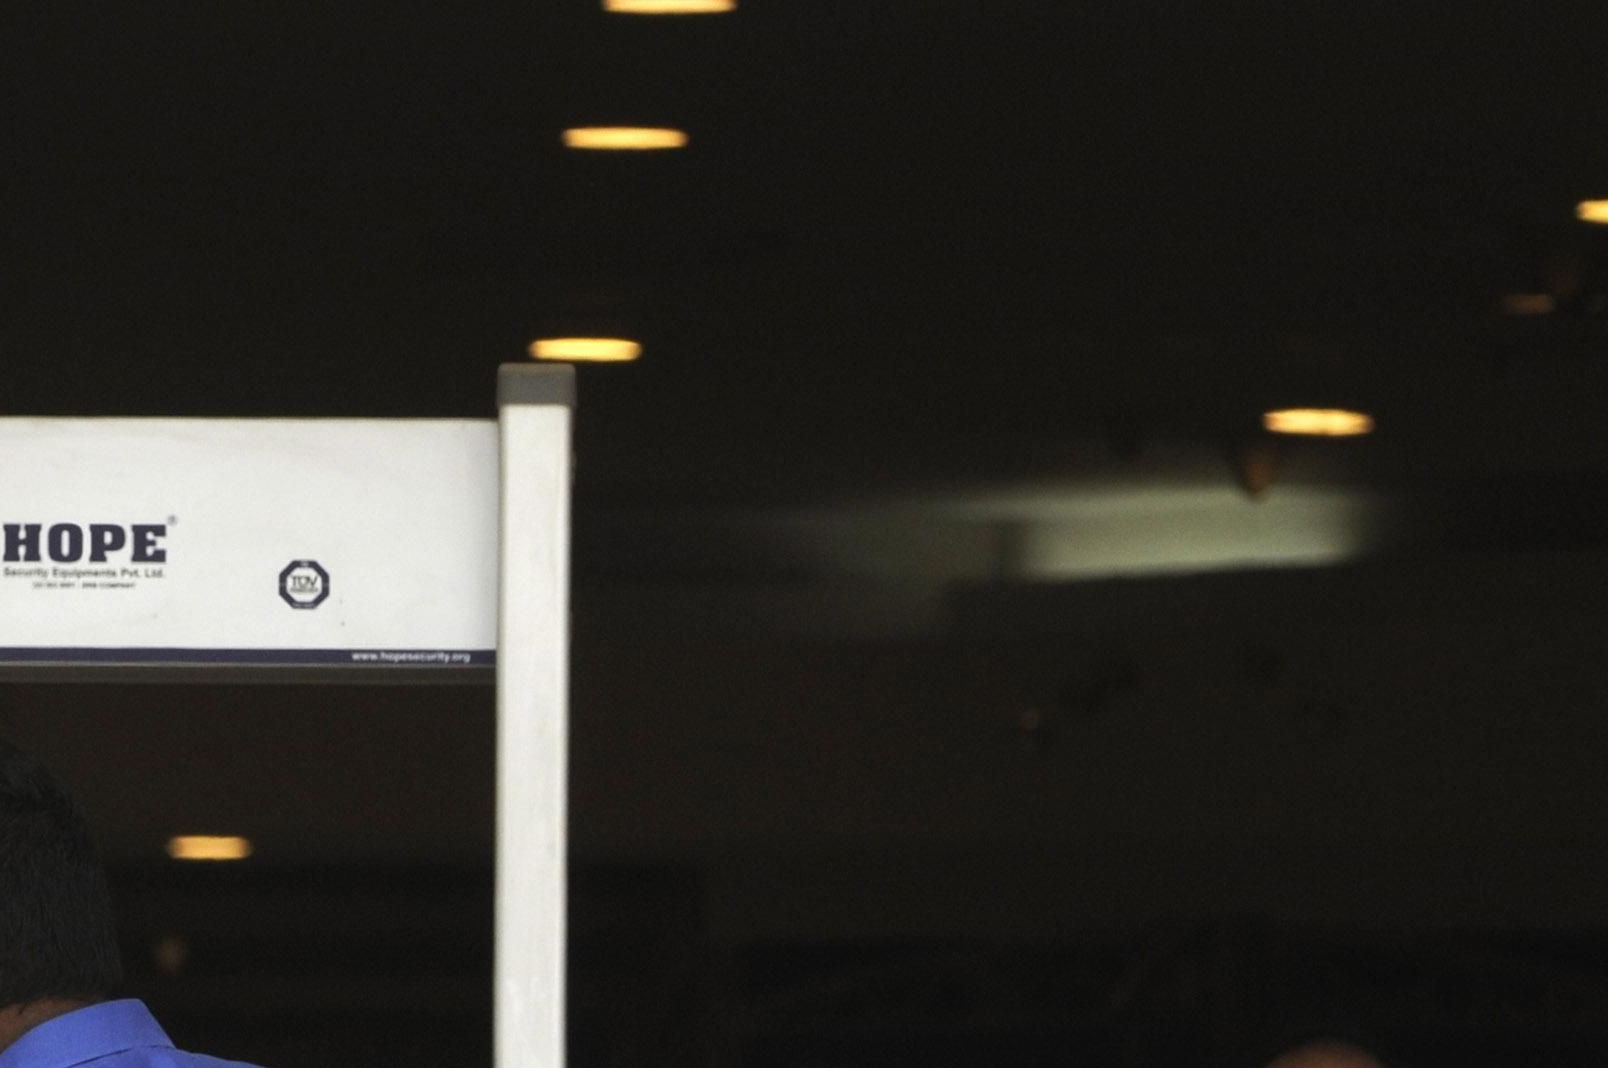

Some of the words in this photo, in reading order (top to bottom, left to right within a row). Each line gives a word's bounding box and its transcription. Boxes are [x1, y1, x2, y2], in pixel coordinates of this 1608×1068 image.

[2, 523, 167, 563] HOPE
[3, 567, 48, 579] Security
[52, 567, 117, 579] Equipments
[120, 568, 141, 578] Pvt.
[144, 568, 165, 578] Ltd.
[351, 651, 471, 663] www.hopesecurity.org
